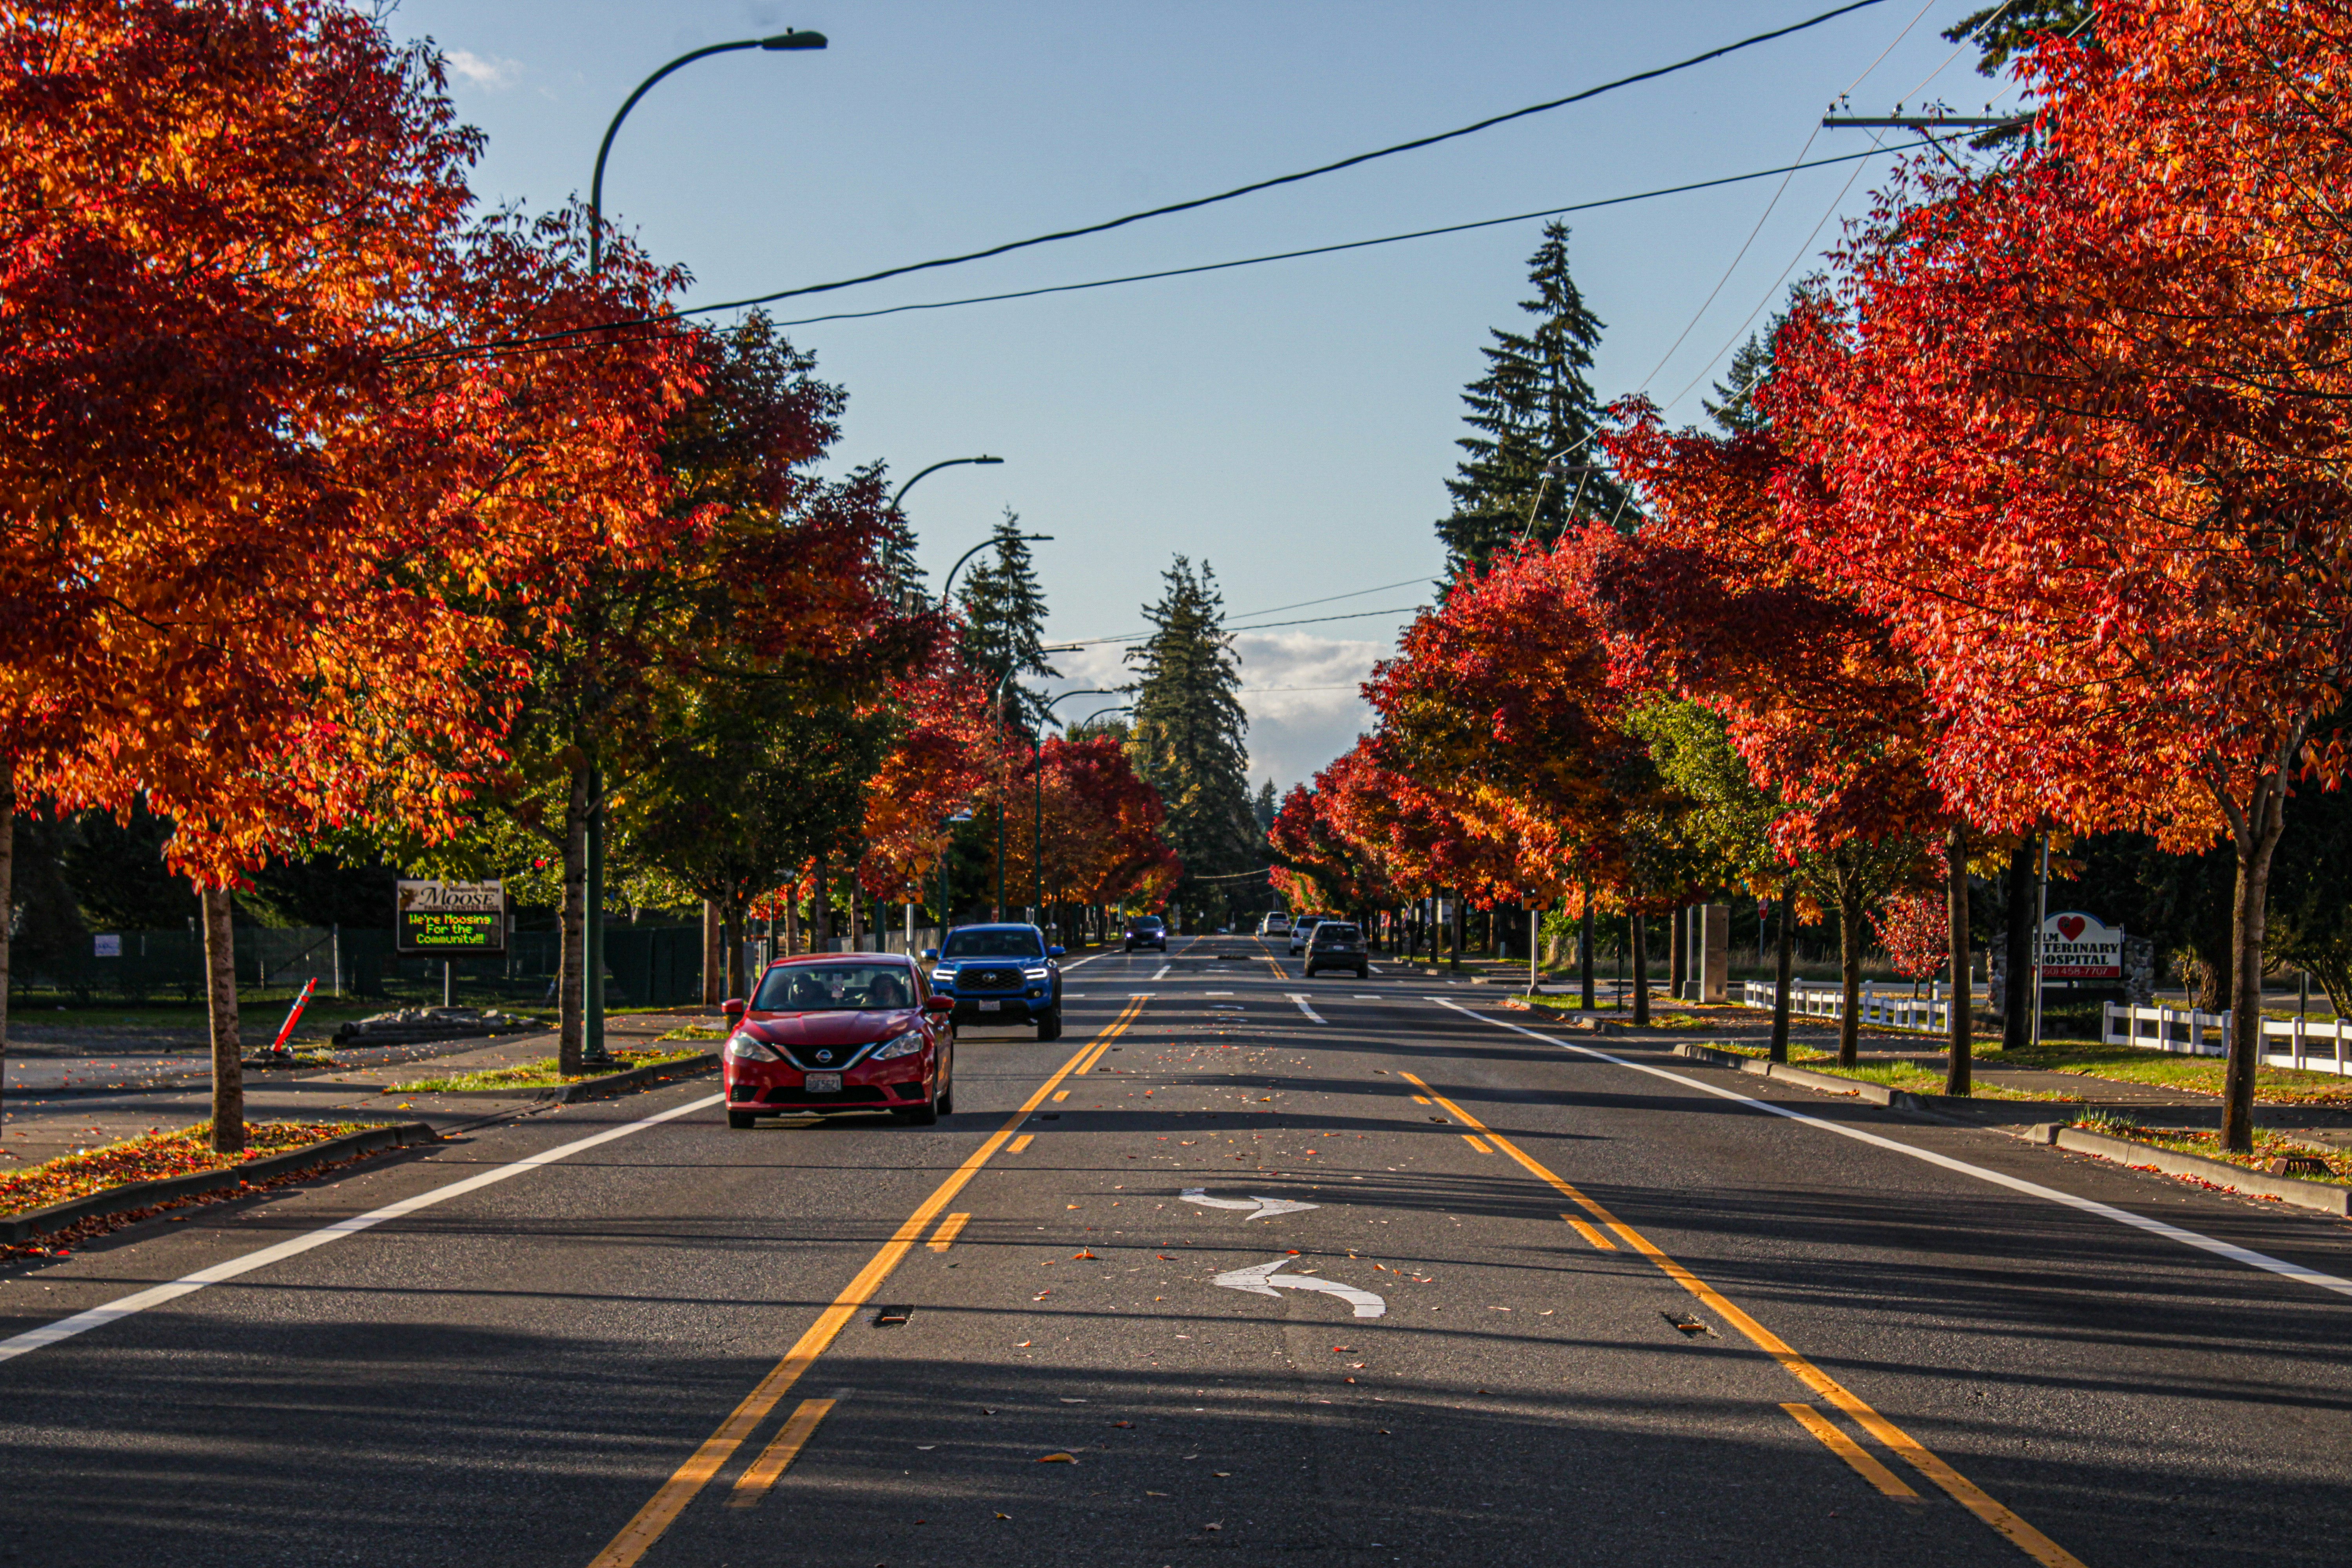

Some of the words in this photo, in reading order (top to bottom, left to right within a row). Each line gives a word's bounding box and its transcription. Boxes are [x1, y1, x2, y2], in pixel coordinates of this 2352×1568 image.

[408, 913, 441, 924] We're
[444, 913, 492, 924] Moosing
[426, 924, 449, 933] For
[452, 924, 474, 933] the
[2061, 967, 2108, 975] 458-7707
